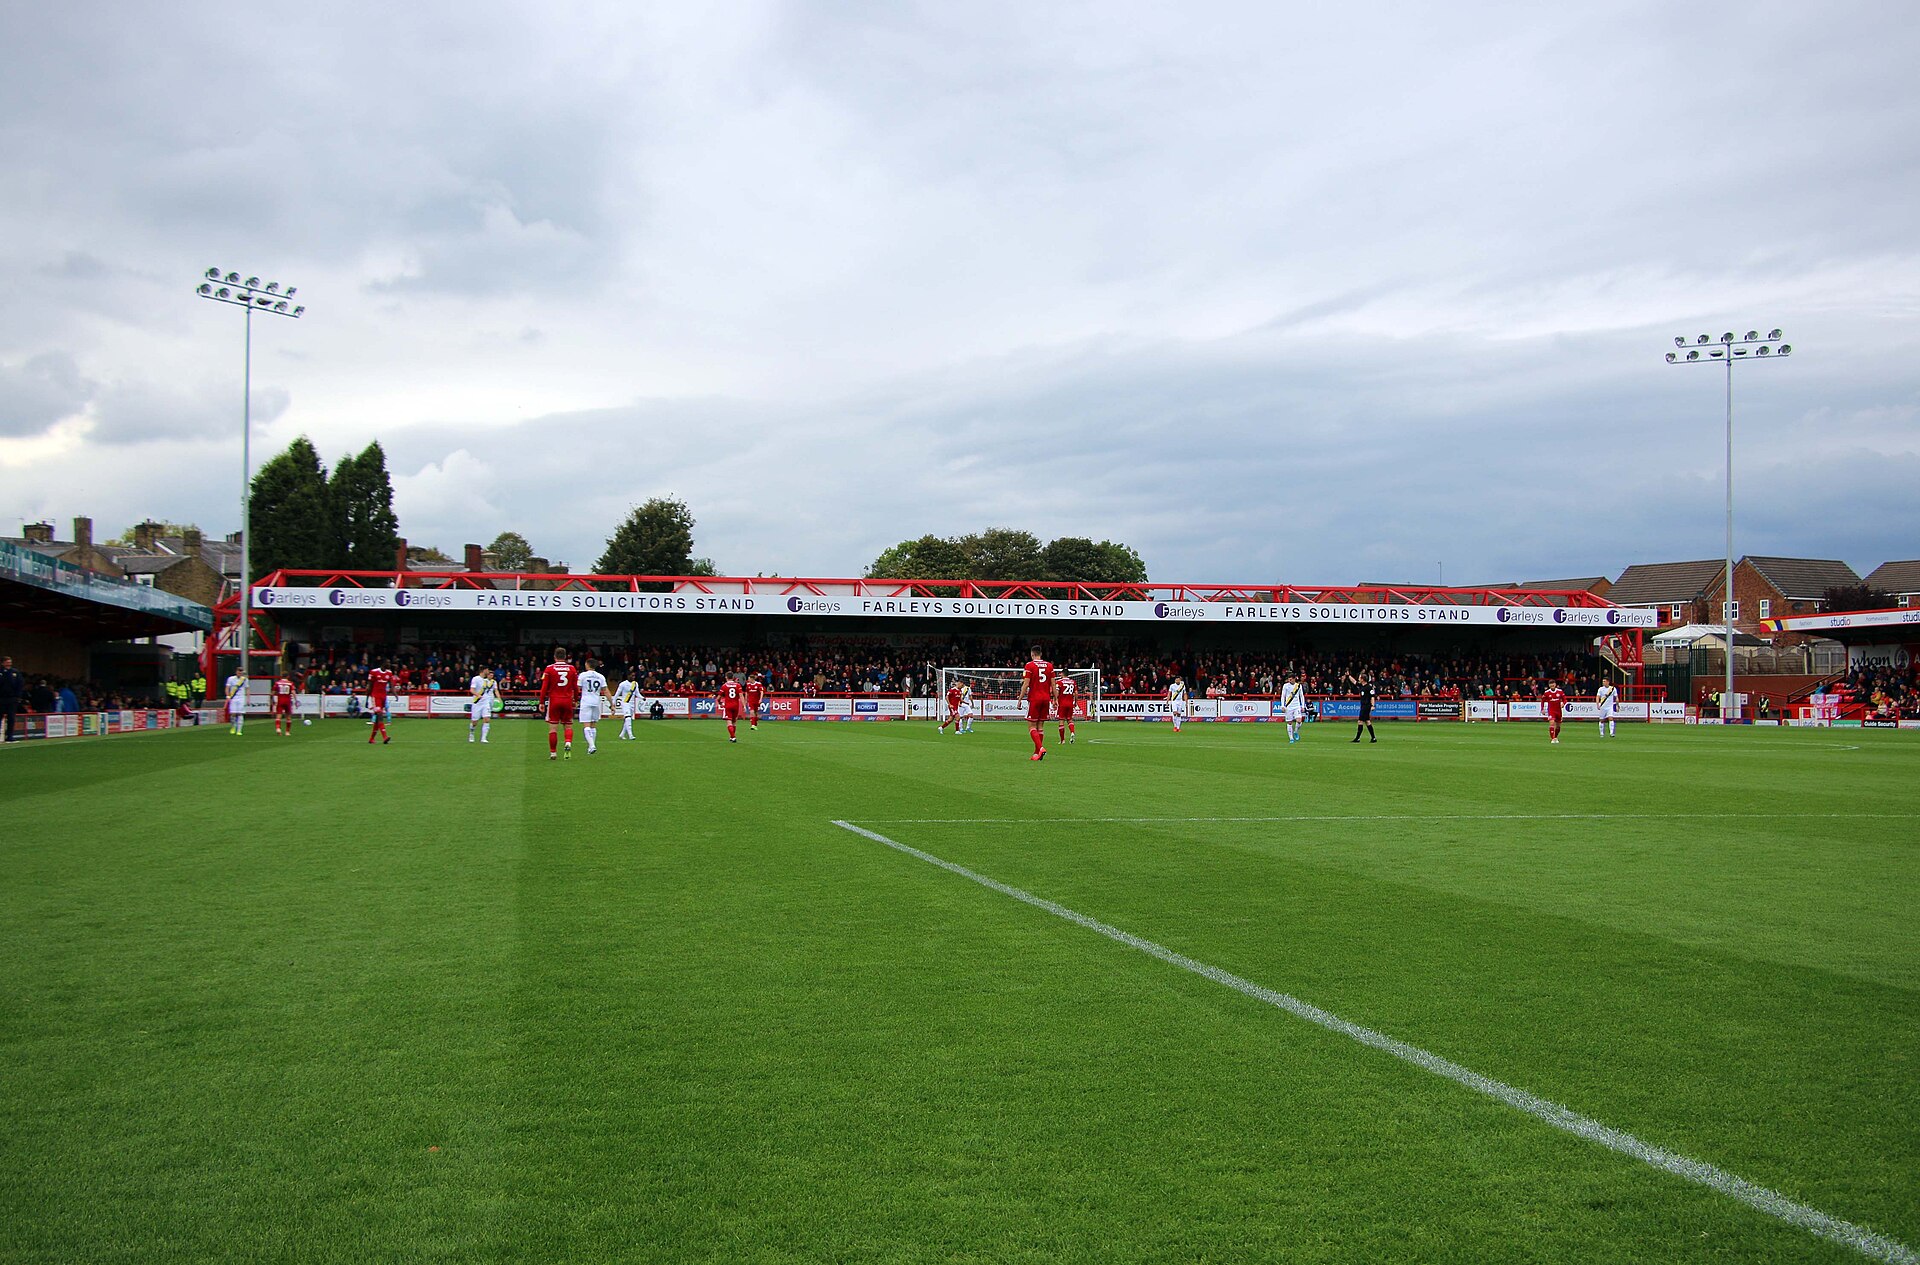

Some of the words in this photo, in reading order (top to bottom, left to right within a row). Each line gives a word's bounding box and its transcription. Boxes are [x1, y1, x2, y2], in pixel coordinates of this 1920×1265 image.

[259, 588, 316, 607] Farleys
[329, 589, 386, 607] Farleys
[395, 590, 451, 608] Farleys
[476, 595, 562, 607] FARLEYS
[571, 596, 686, 609] SOLICITORS
[695, 598, 755, 610] STAND
[787, 596, 840, 613] Farleys
[863, 601, 944, 613] FARLEYS
[952, 602, 1059, 615] SOLICITORS
[1068, 604, 1125, 616] STAND
[1154, 602, 1205, 619] Farleys
[1225, 606, 1301, 618] FARLEYS
[1309, 607, 1410, 619] SOLICITORS
[1418, 609, 1470, 620] STAND
[1497, 607, 1543, 623] Farleys
[1553, 608, 1600, 624] Farleys
[1606, 609, 1652, 625] Farleys
[1830, 617, 1851, 627] studio
[557, 671, 568, 686] 3
[1038, 668, 1046, 682] 5
[586, 680, 601, 692] 19
[728, 688, 736, 698] 8
[1062, 684, 1075, 694] 28
[696, 700, 715, 712] sky
[772, 701, 792, 710] bet
[1565, 703, 1593, 712] Farleys
[1877, 720, 1896, 728] Security
